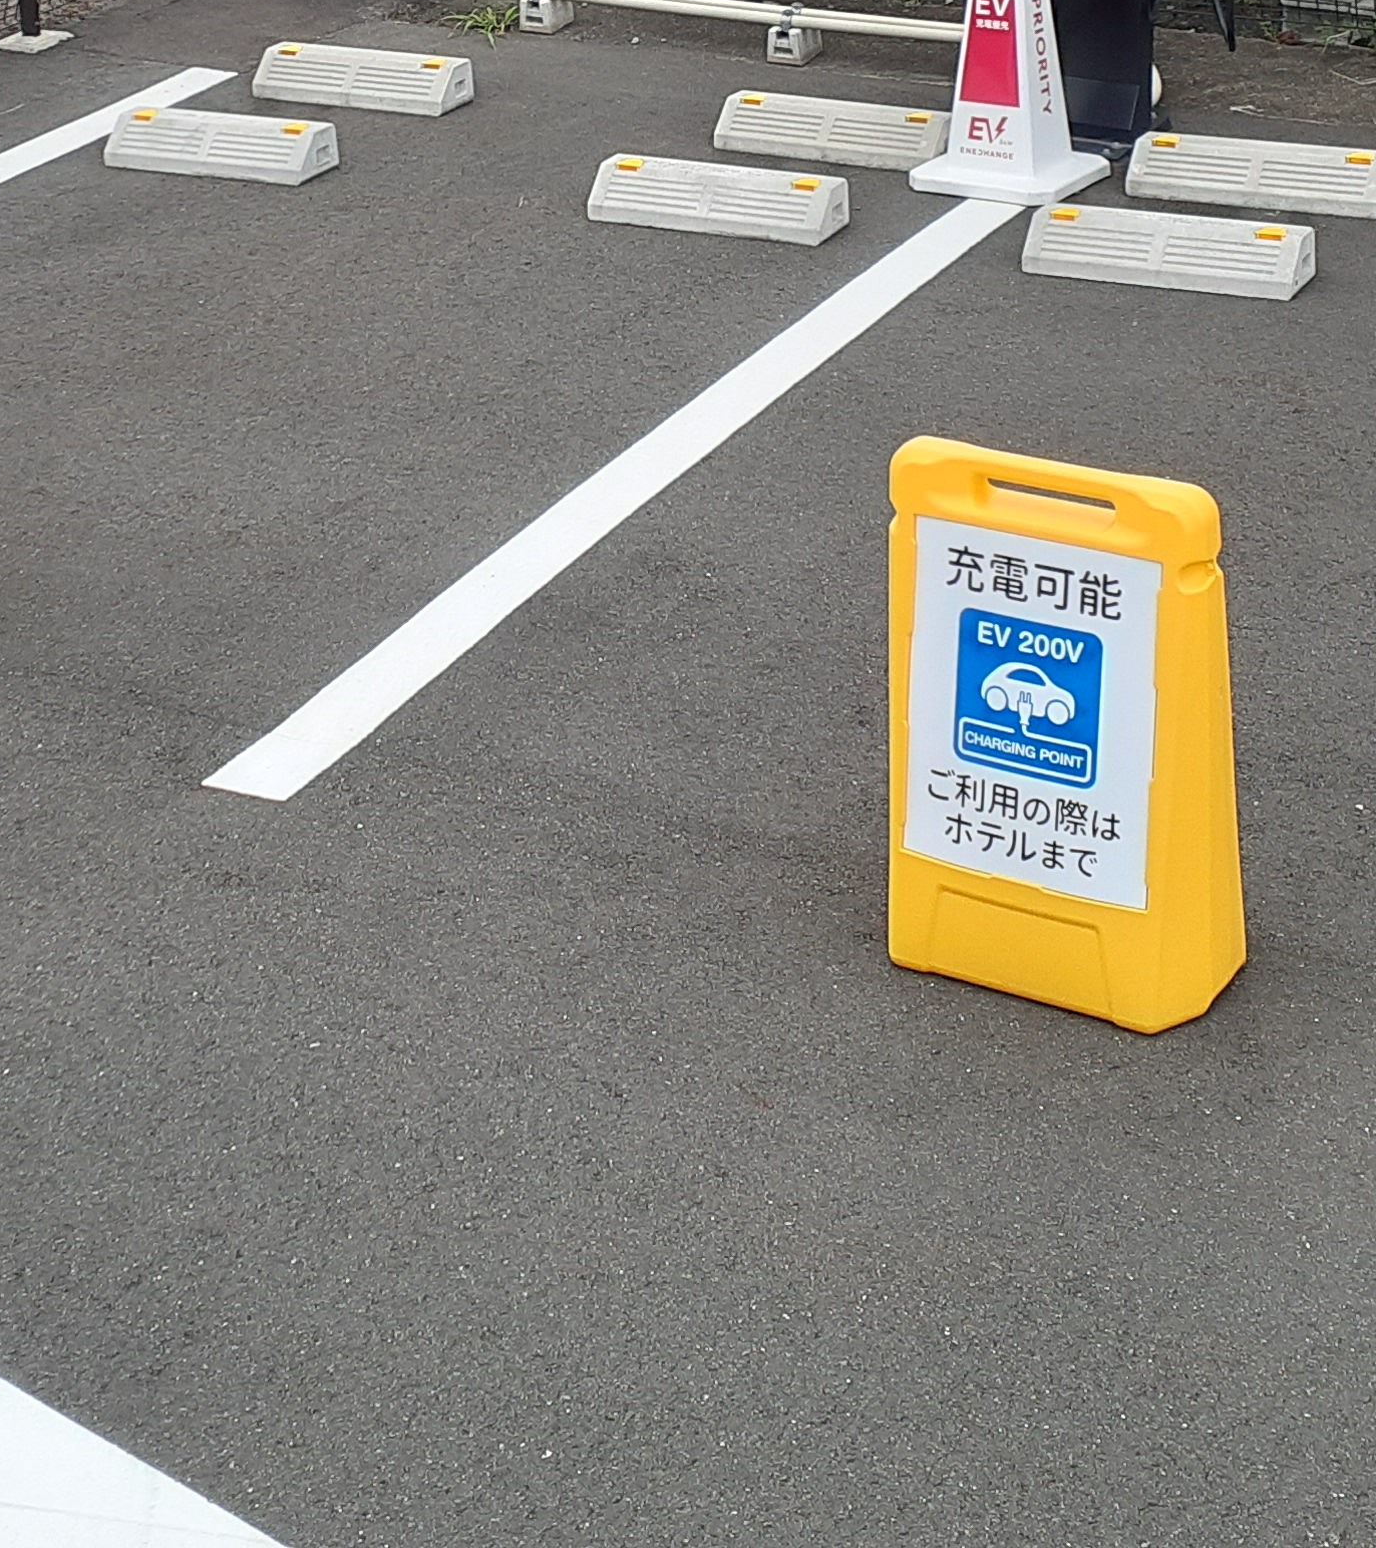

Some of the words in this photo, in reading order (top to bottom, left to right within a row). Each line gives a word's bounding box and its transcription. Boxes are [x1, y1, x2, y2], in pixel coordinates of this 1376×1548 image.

[967, 116, 1009, 144] EV
[946, 545, 1122, 621] 充電可能
[977, 620, 1012, 648] EV
[1018, 630, 1084, 664] 200V
[964, 730, 1036, 760] CHARGING
[1039, 748, 1084, 770] POINT
[928, 769, 1121, 841] ご利用の際は
[945, 813, 1098, 878] ホテルまで
